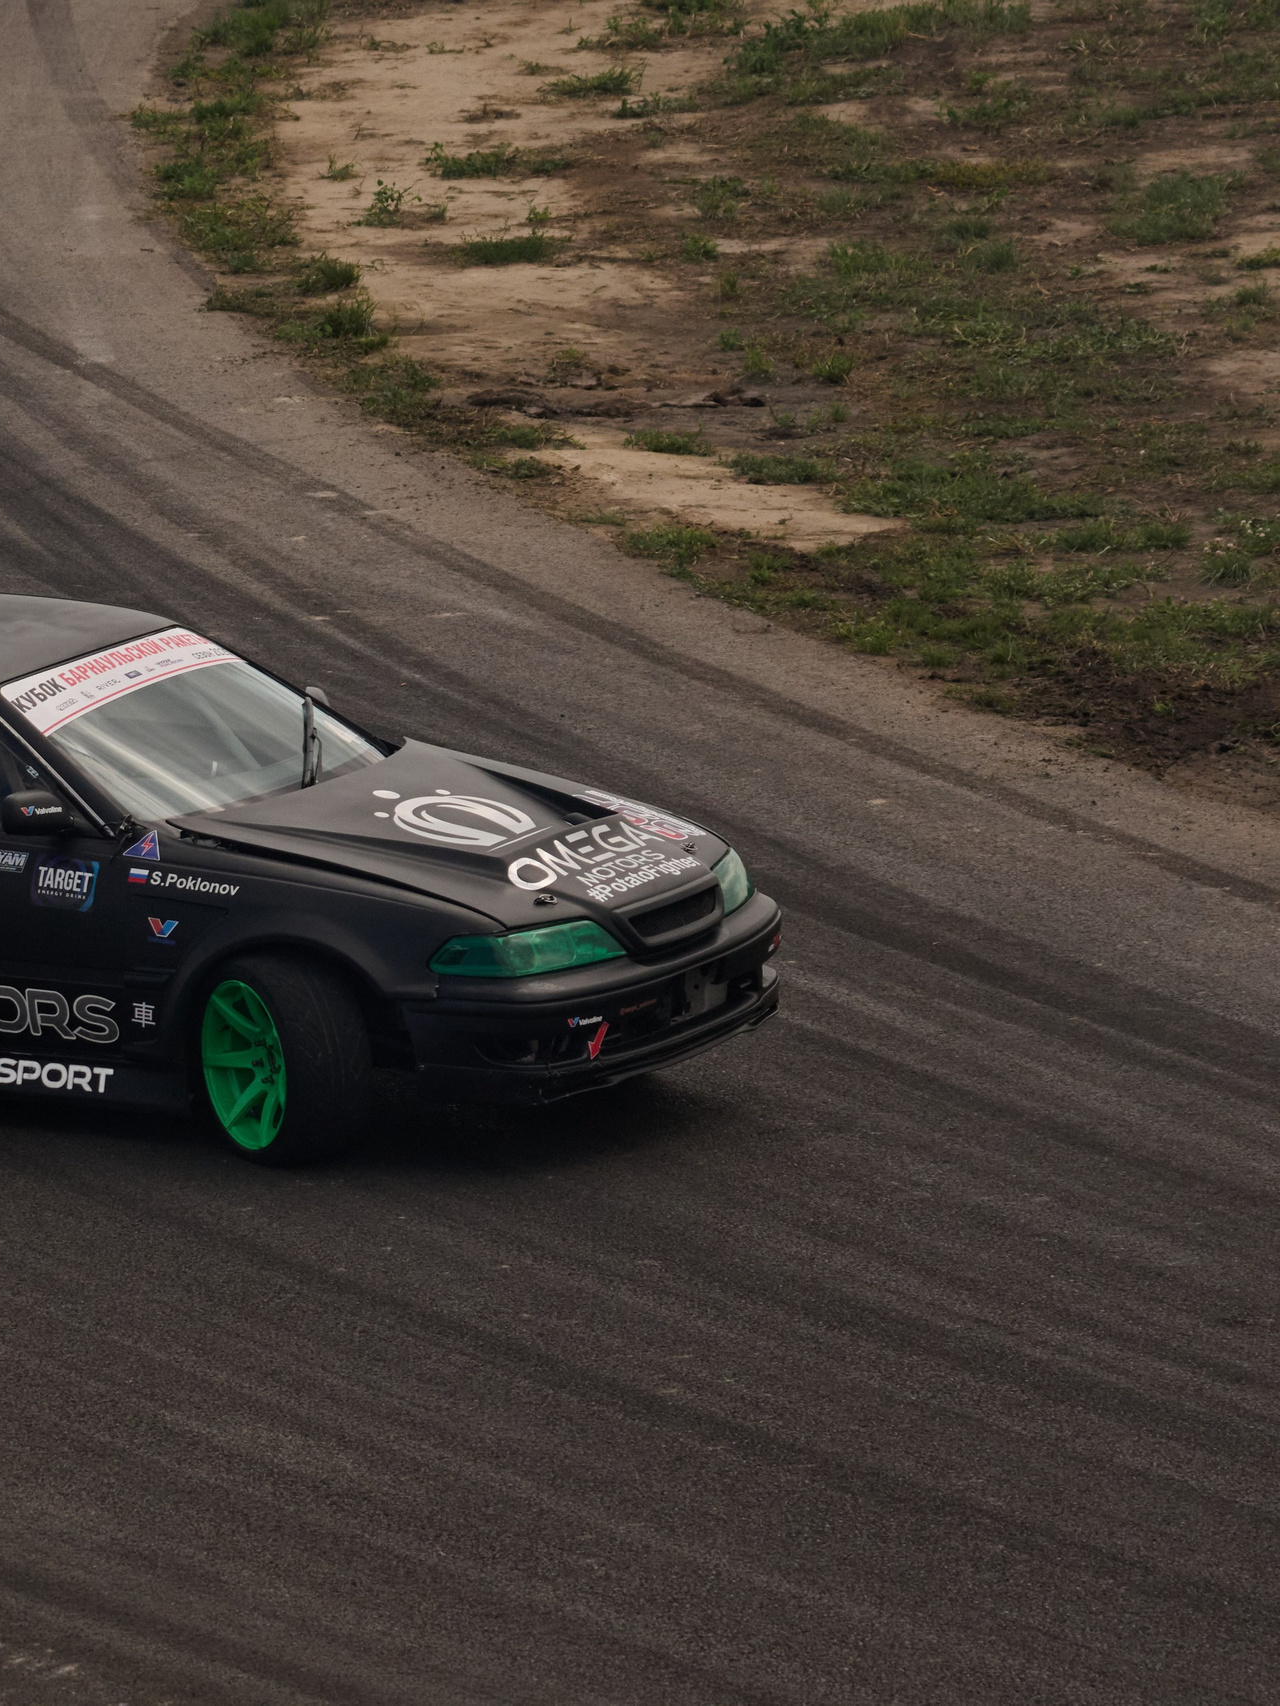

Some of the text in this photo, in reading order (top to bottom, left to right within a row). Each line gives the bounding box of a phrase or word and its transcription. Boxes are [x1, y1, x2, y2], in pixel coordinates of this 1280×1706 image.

[11, 677, 67, 713] КУБОК
[58, 638, 166, 687] БАРНАУЛЬСКОЙ
[508, 821, 666, 890] OMEGA
[576, 849, 665, 887] MOTORS
[37, 889, 86, 900] ENERGY DRINK
[38, 866, 94, 893] TARGET
[150, 871, 239, 896] S.Poklonov
[587, 856, 701, 902] #PotatoFighter
[131, 1001, 156, 1028] 車
